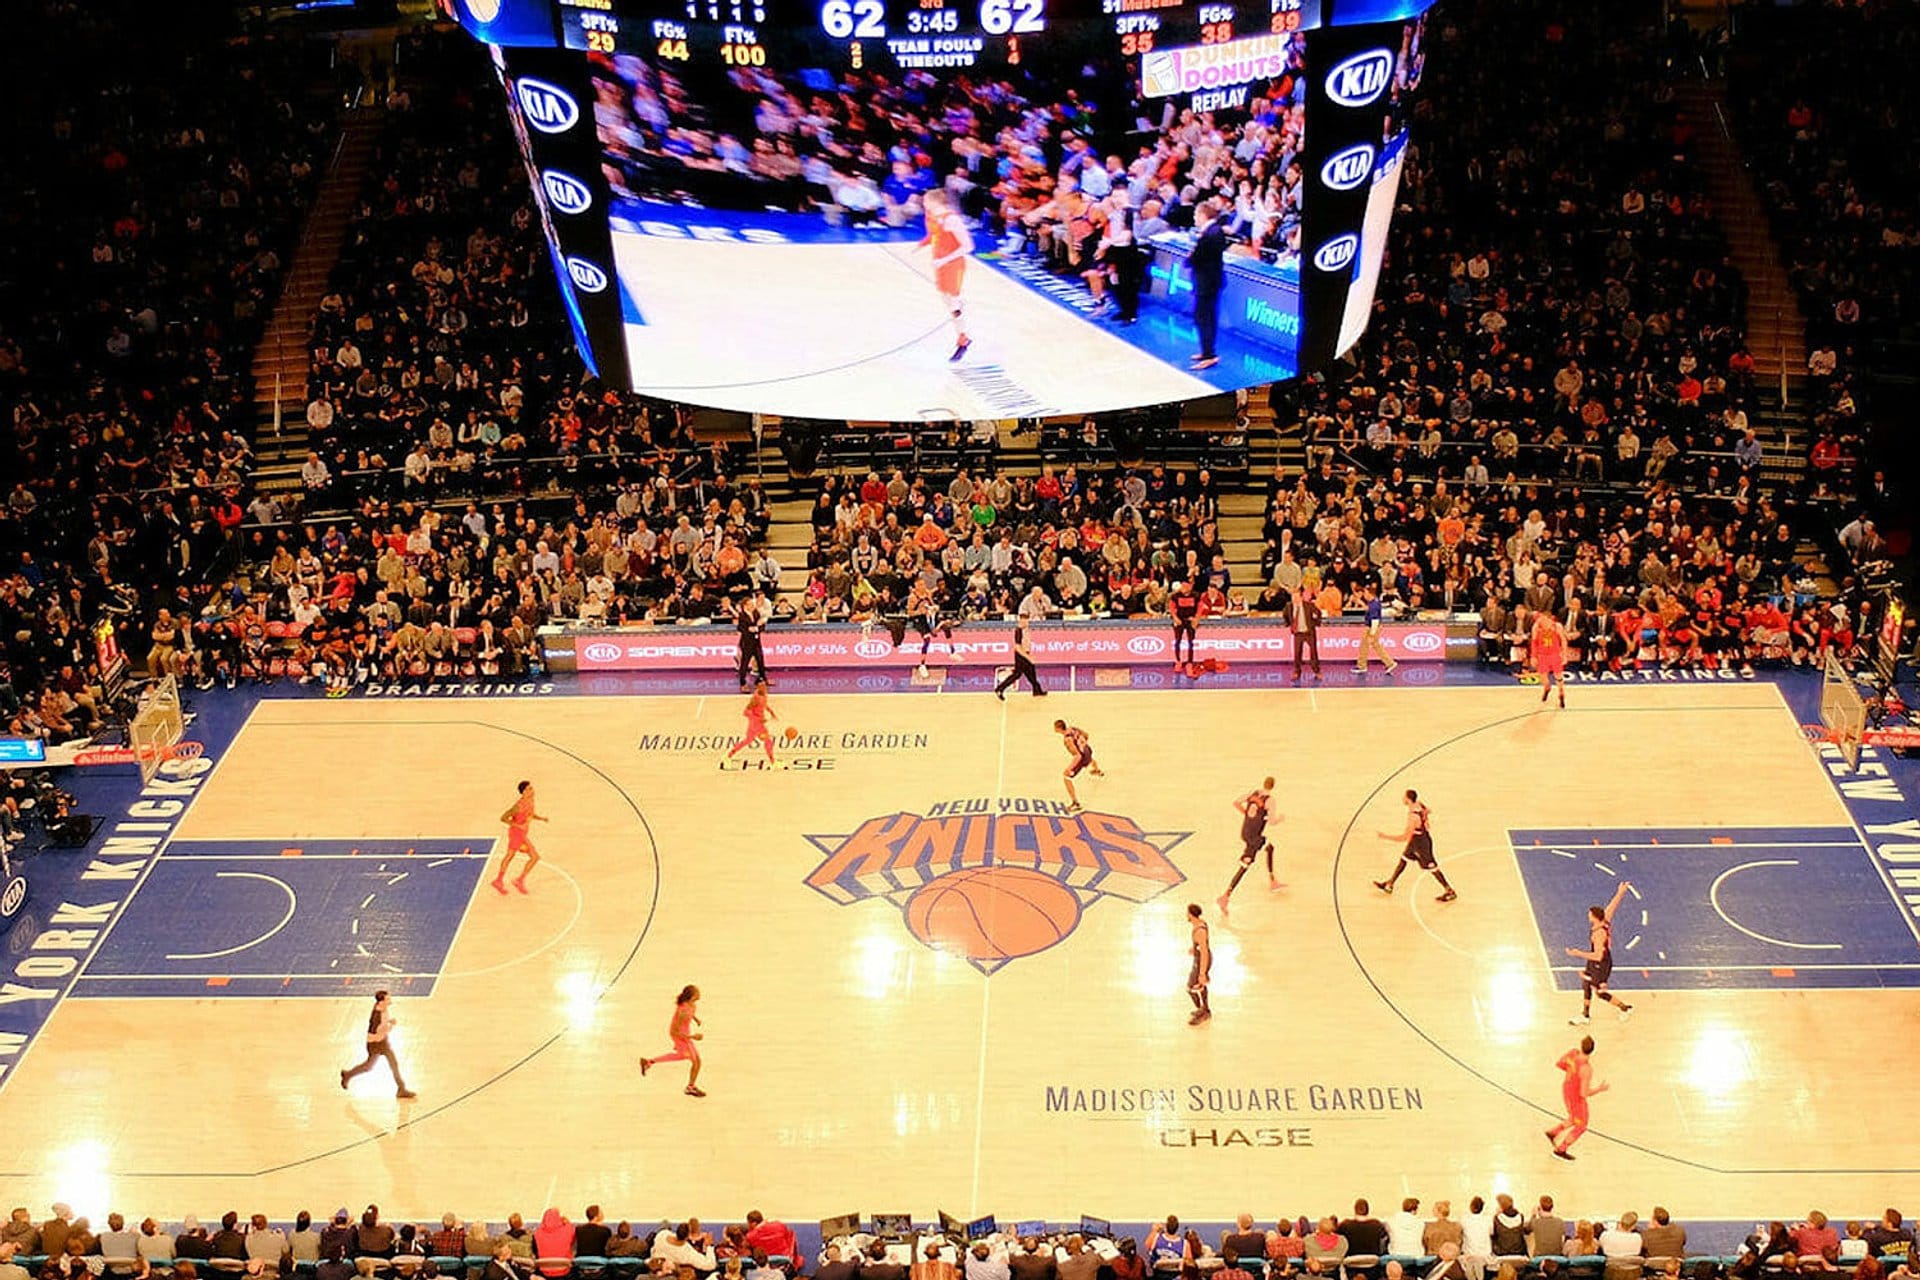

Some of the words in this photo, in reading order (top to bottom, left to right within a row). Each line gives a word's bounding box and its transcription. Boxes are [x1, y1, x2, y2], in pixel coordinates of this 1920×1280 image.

[580, 13, 619, 33] 3PT%
[821, 0, 886, 38] 62
[907, 11, 958, 33] 3:45
[980, 0, 1045, 34] 62
[1115, 15, 1159, 35] 3PT%
[1199, 7, 1233, 25] FG%
[1271, 11, 1300, 33] 89
[653, 21, 687, 40] FG%
[724, 26, 757, 44] FT%
[1200, 23, 1232, 44] 38
[587, 31, 616, 52] 29
[657, 40, 690, 61] 44
[887, 39, 930, 53] TEAM
[934, 38, 983, 52] FOULS
[1121, 32, 1154, 56] 35
[720, 45, 766, 66] 100
[897, 55, 975, 68] TIMEOUTS
[1184, 55, 1282, 88] DONUTS
[1338, 54, 1386, 97] KIA
[520, 86, 567, 123] KIA
[1191, 87, 1248, 114] REPLAY
[1331, 153, 1371, 184] KIA
[545, 176, 583, 207] KIA
[1246, 296, 1300, 337] Winners
[627, 645, 738, 658] SORENTO
[775, 644, 801, 656] MVP
[803, 643, 817, 655] of
[899, 641, 1009, 654] SORENTO
[1047, 640, 1074, 652] MVP
[1076, 639, 1090, 651] of
[365, 682, 556, 696] DRAFTKINGS
[639, 733, 742, 752] MADISON
[746, 733, 834, 751] SUARE
[841, 731, 930, 750] GARDEN
[718, 758, 837, 772] CHSE
[925, 798, 990, 818] NEW
[997, 797, 1071, 817] YORK
[802, 811, 1188, 906] KNICKS
[1863, 818, 1920, 919] YO
[0, 900, 119, 1004] YORK
[81, 756, 214, 881] KNICKS
[1045, 1084, 1177, 1113] MADISON
[1187, 1083, 1300, 1114] SQUARE
[1308, 1082, 1425, 1112] GARDEN
[1159, 1126, 1315, 1149] CHASE
